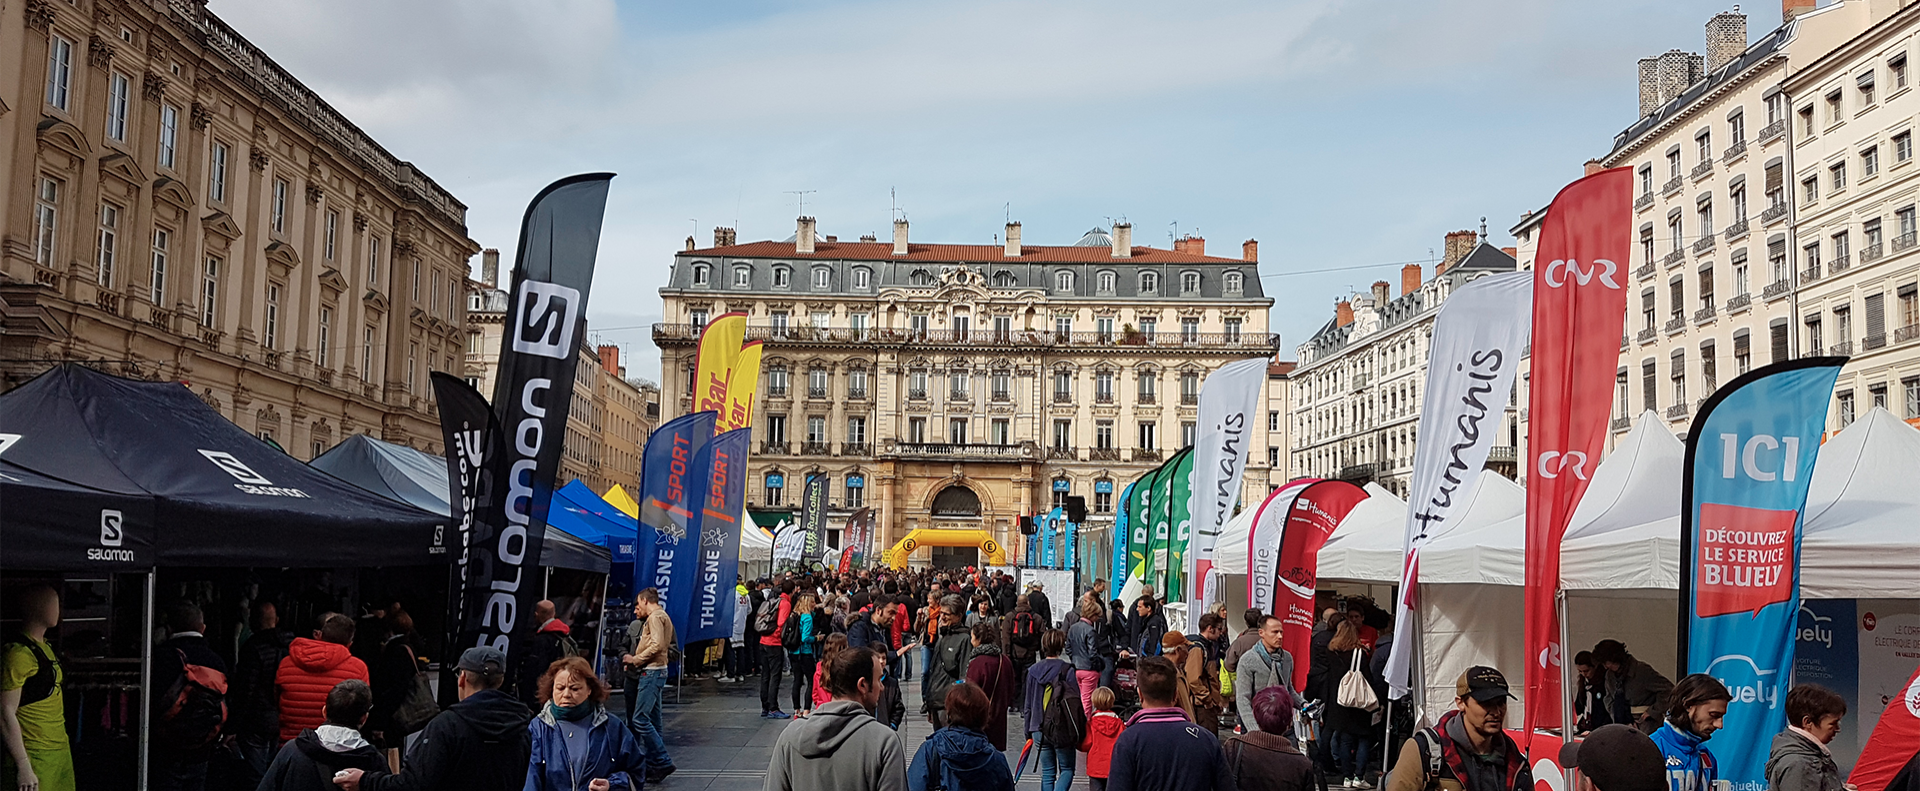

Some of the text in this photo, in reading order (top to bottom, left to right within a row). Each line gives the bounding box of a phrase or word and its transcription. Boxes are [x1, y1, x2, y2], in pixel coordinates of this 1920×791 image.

[1544, 258, 1621, 290] CNR
[667, 432, 690, 503] SPORT
[1720, 433, 1800, 482] ICI
[234, 483, 312, 498] salomon
[711, 447, 729, 510] SPORT
[807, 481, 819, 530] RunCollect
[1308, 501, 1337, 526] Humanis
[1705, 526, 1788, 546] DÉCOUVREZ
[87, 548, 134, 562] salomon
[1704, 547, 1784, 563] LE SERVICE
[655, 549, 674, 611] UASNE
[700, 550, 720, 629] THUASNE
[1704, 563, 1784, 587] BLUELY
[1795, 624, 1832, 649] uely
[1726, 679, 1778, 710] uely
